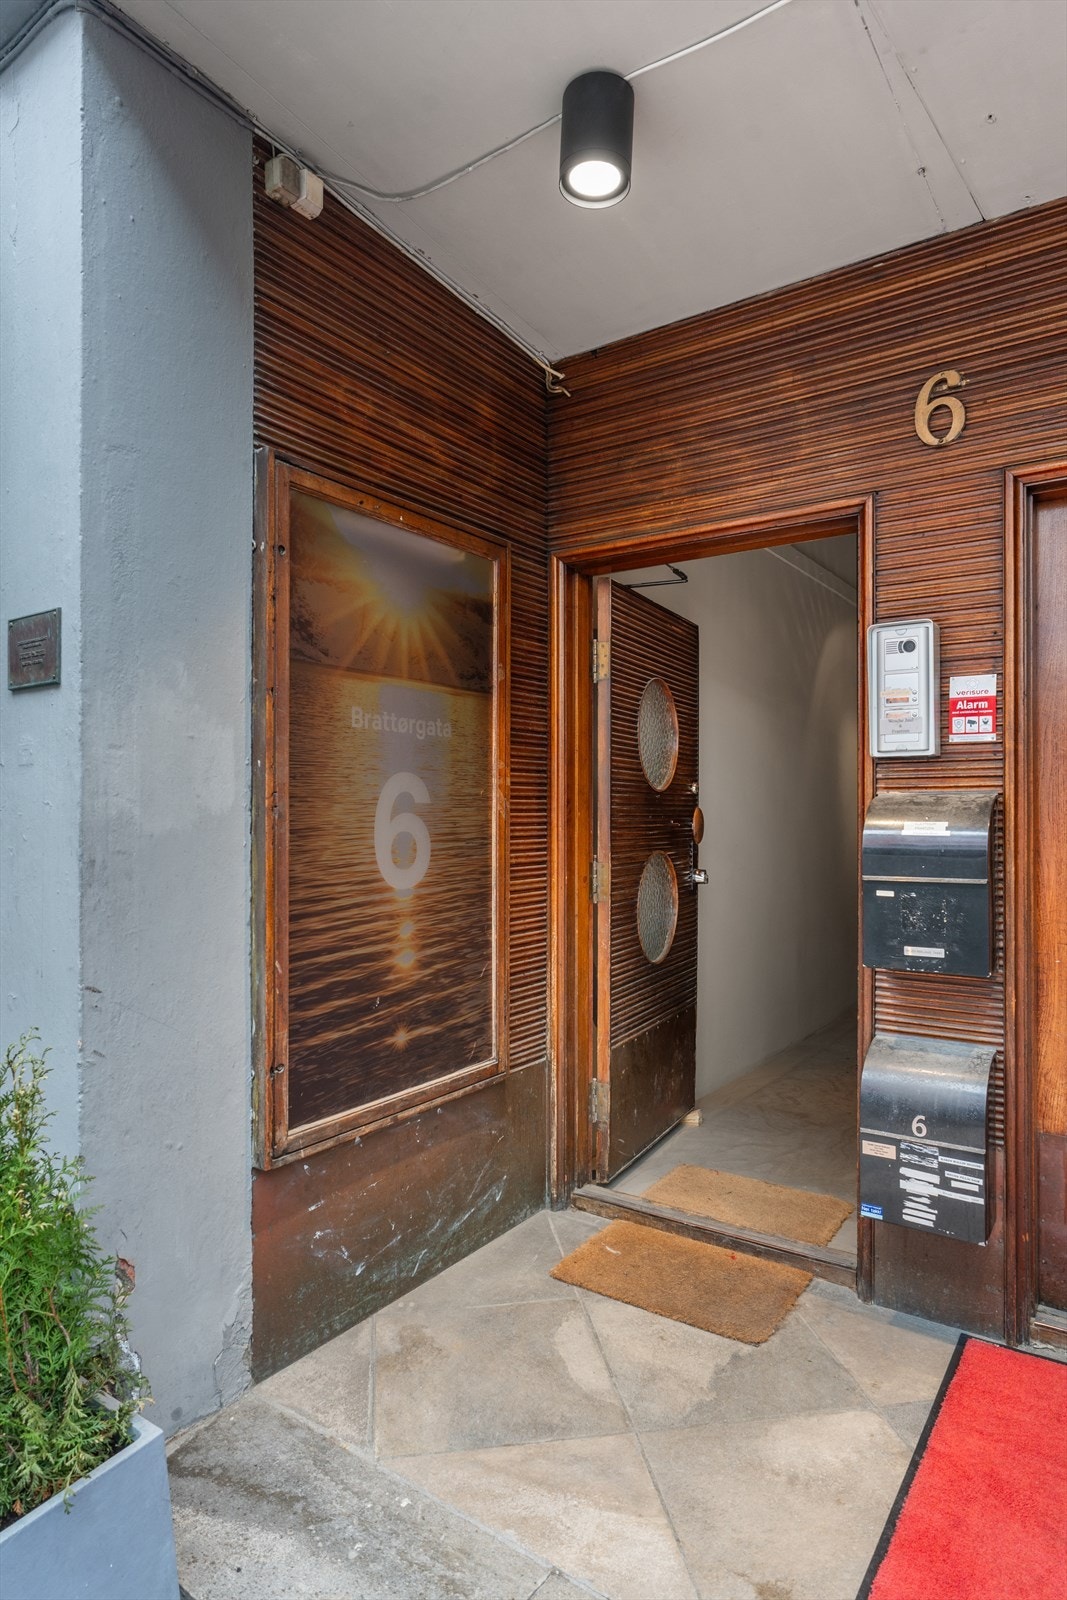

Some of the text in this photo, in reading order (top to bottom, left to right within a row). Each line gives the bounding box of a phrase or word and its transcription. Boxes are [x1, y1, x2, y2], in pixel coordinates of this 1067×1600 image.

[914, 369, 966, 446] 6
[351, 705, 453, 740] Brattørgata
[956, 700, 989, 710] Alarm
[374, 771, 432, 890] 6
[911, 1115, 928, 1138] 6
